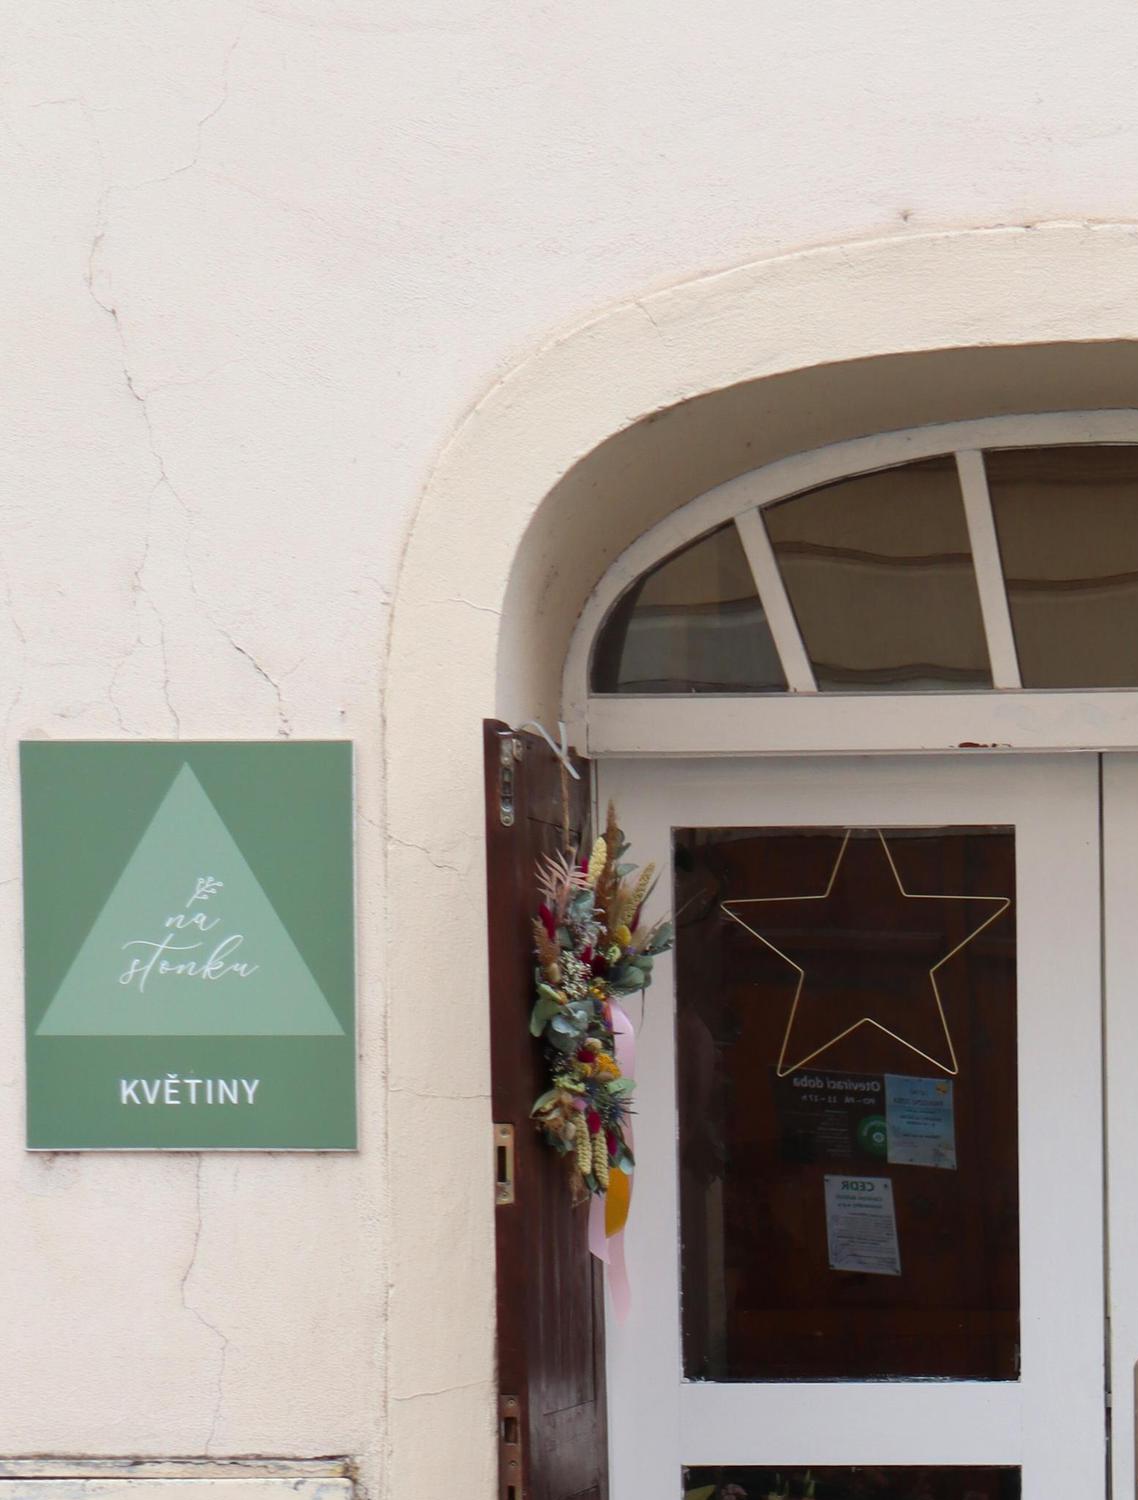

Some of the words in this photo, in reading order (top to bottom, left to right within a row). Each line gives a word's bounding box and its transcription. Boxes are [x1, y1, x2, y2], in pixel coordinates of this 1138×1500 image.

[165, 911, 220, 932] na
[118, 933, 259, 993] stonku
[119, 1072, 260, 1104] KVĚTINY
